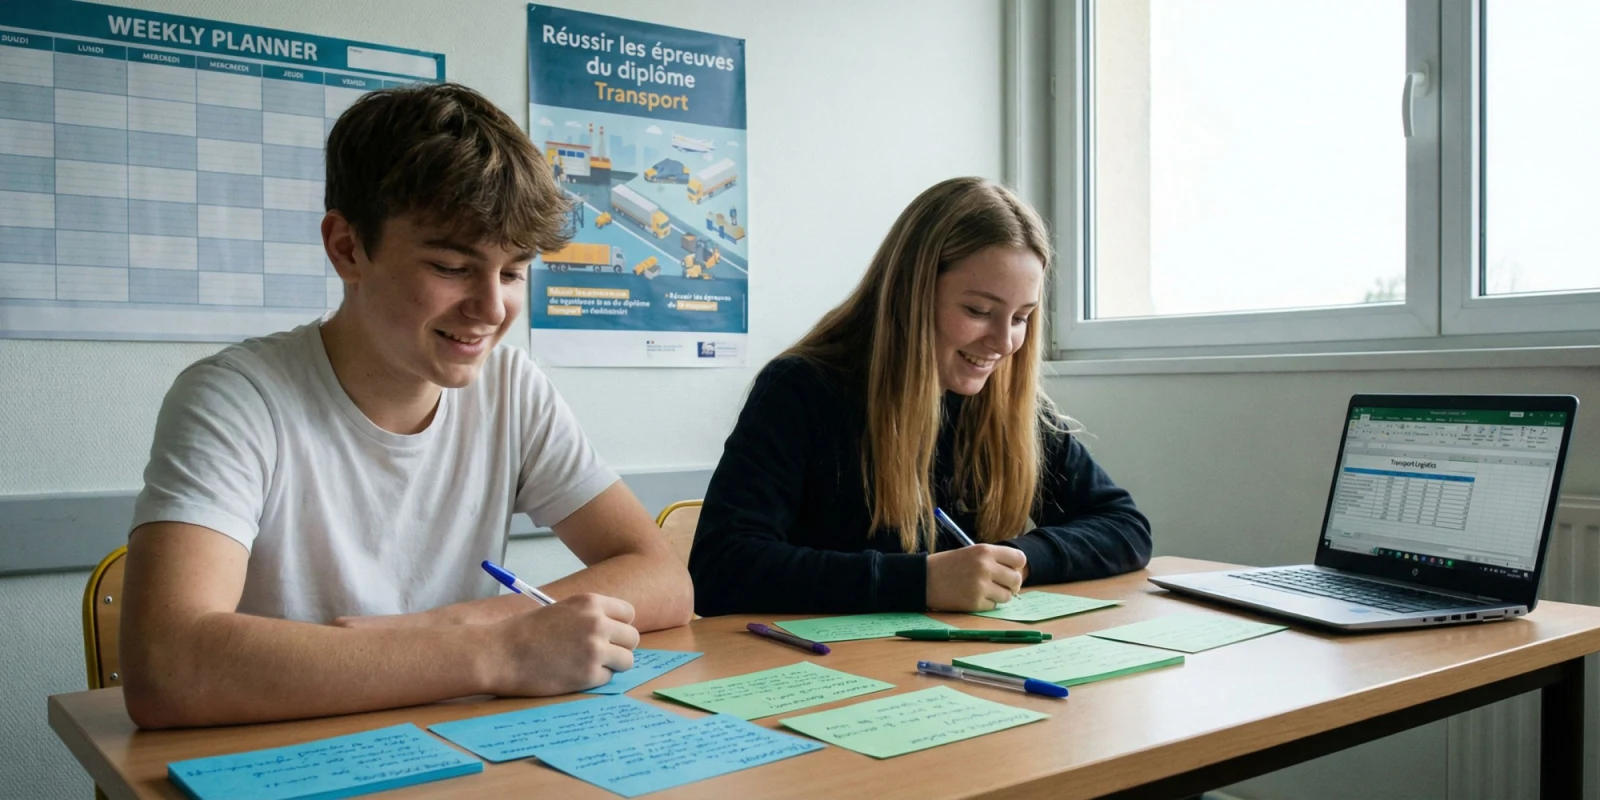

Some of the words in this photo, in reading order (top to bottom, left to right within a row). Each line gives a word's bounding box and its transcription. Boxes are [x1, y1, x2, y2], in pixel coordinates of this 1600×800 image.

[107, 15, 205, 45] WEEKLY
[212, 29, 318, 61] PLANNER
[542, 24, 614, 52] Réussir
[620, 36, 646, 58] les
[652, 41, 734, 71] épreuves
[283, 70, 304, 80] JEUDI
[587, 57, 612, 76] du
[618, 62, 695, 88] diplôme
[595, 82, 689, 111] Transport
